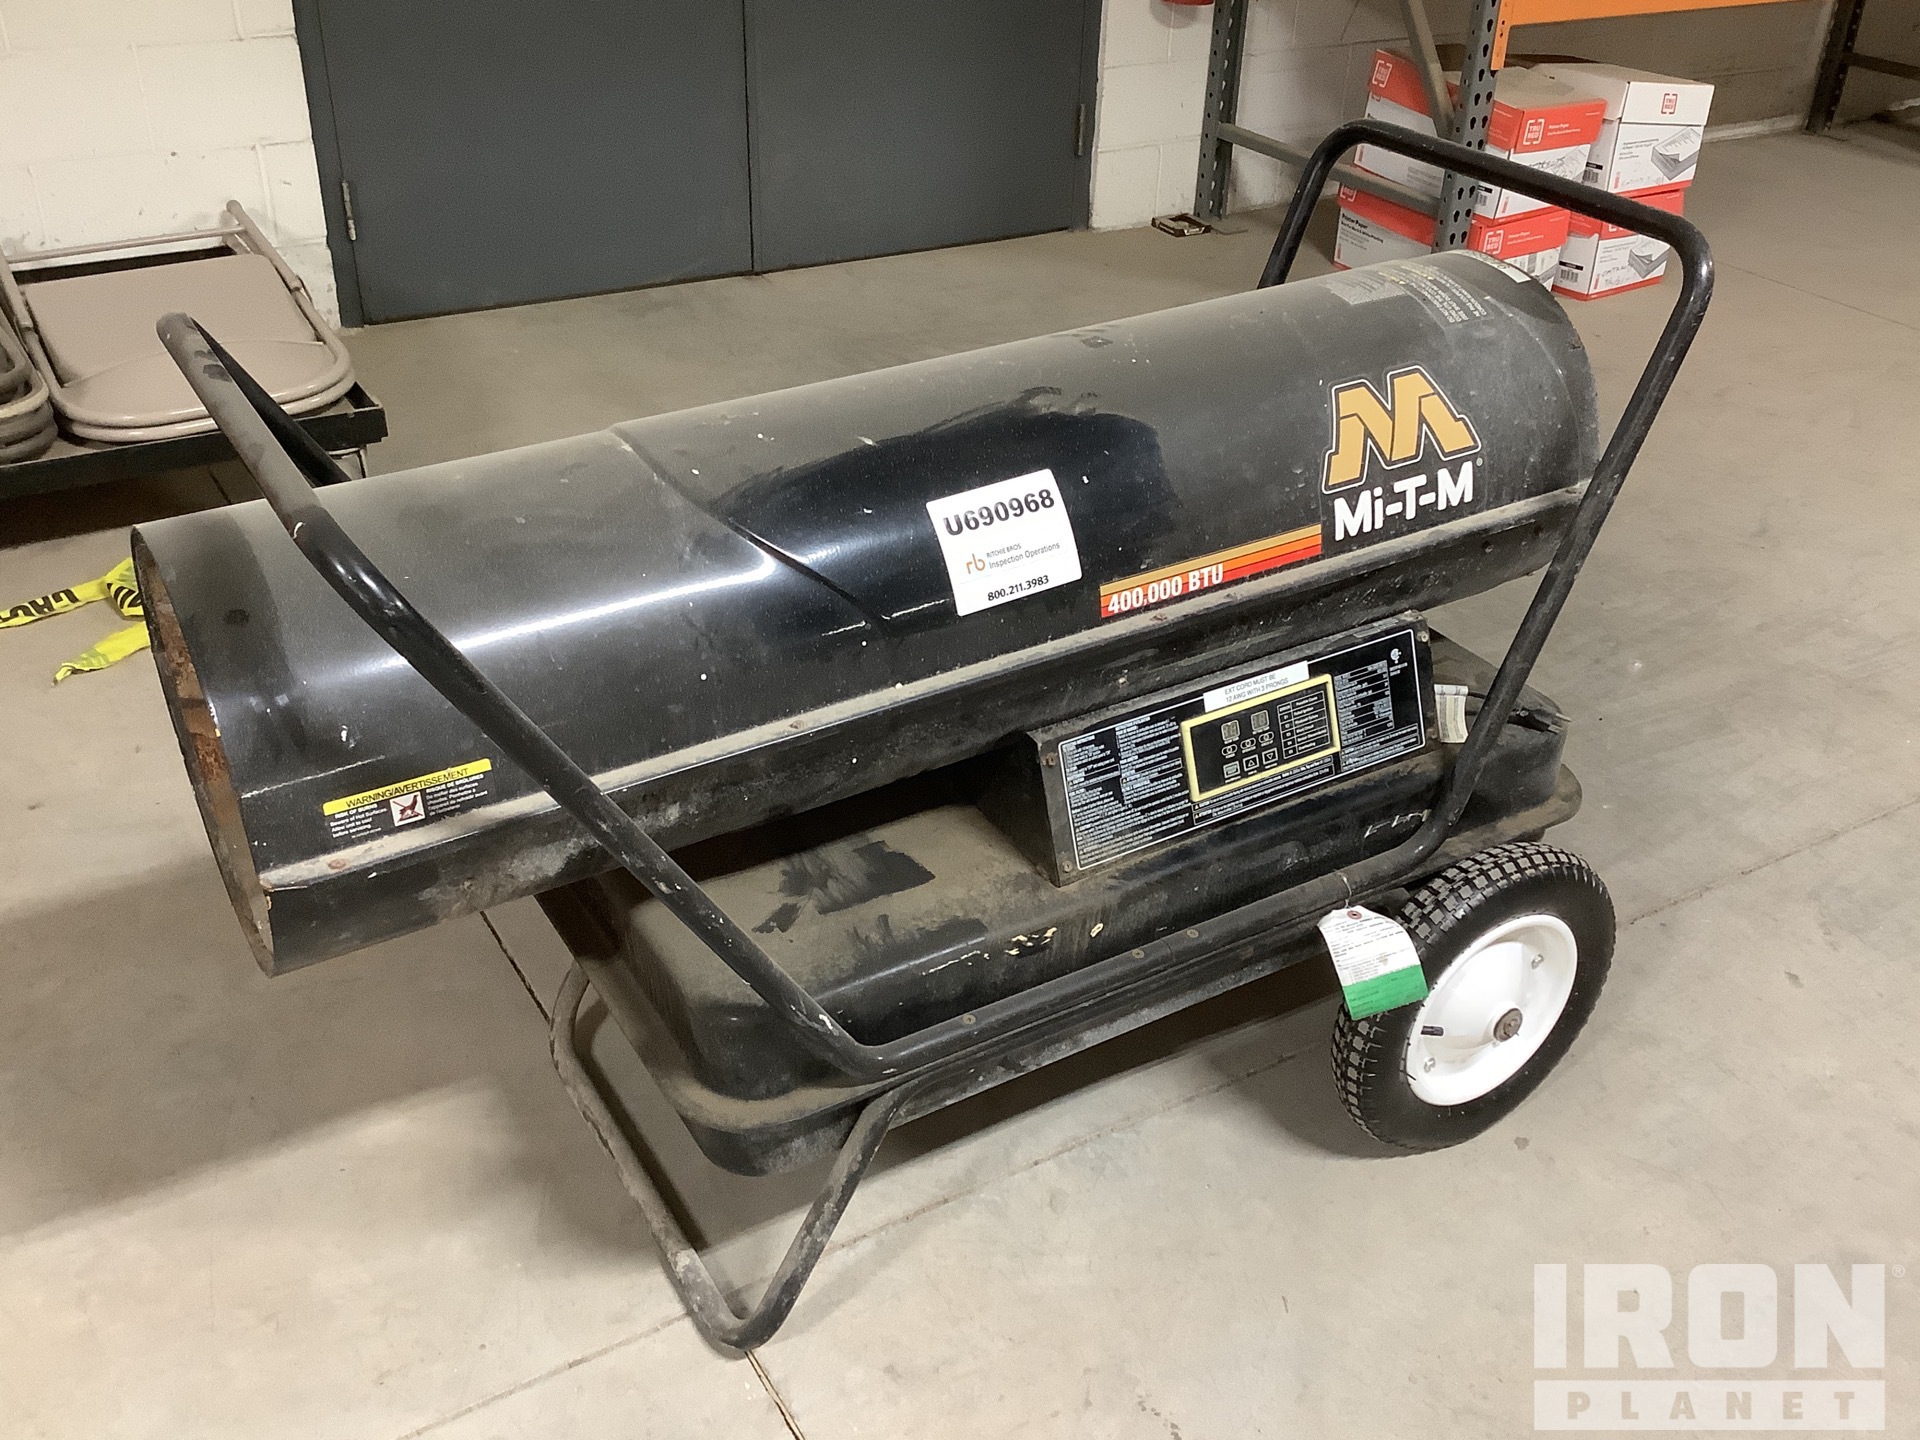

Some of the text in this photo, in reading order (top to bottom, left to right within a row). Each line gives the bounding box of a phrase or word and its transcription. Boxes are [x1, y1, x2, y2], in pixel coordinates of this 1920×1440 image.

[943, 489, 1055, 536] U690968
[1334, 460, 1474, 541] Mi-T-M
[986, 543, 1022, 559] RITCHIE BROS
[989, 542, 1060, 569] Inspection Operations
[987, 574, 1049, 601] 800.211.3983
[1107, 564, 1224, 614] 400,000 BTU
[1224, 673, 1276, 695] EXT CORD MUST BE
[1233, 691, 1246, 700] AWG
[1247, 687, 1261, 696] WITH
[1266, 677, 1289, 690] PRONGS
[345, 768, 469, 808] WARNING/AVERTISSEMENT
